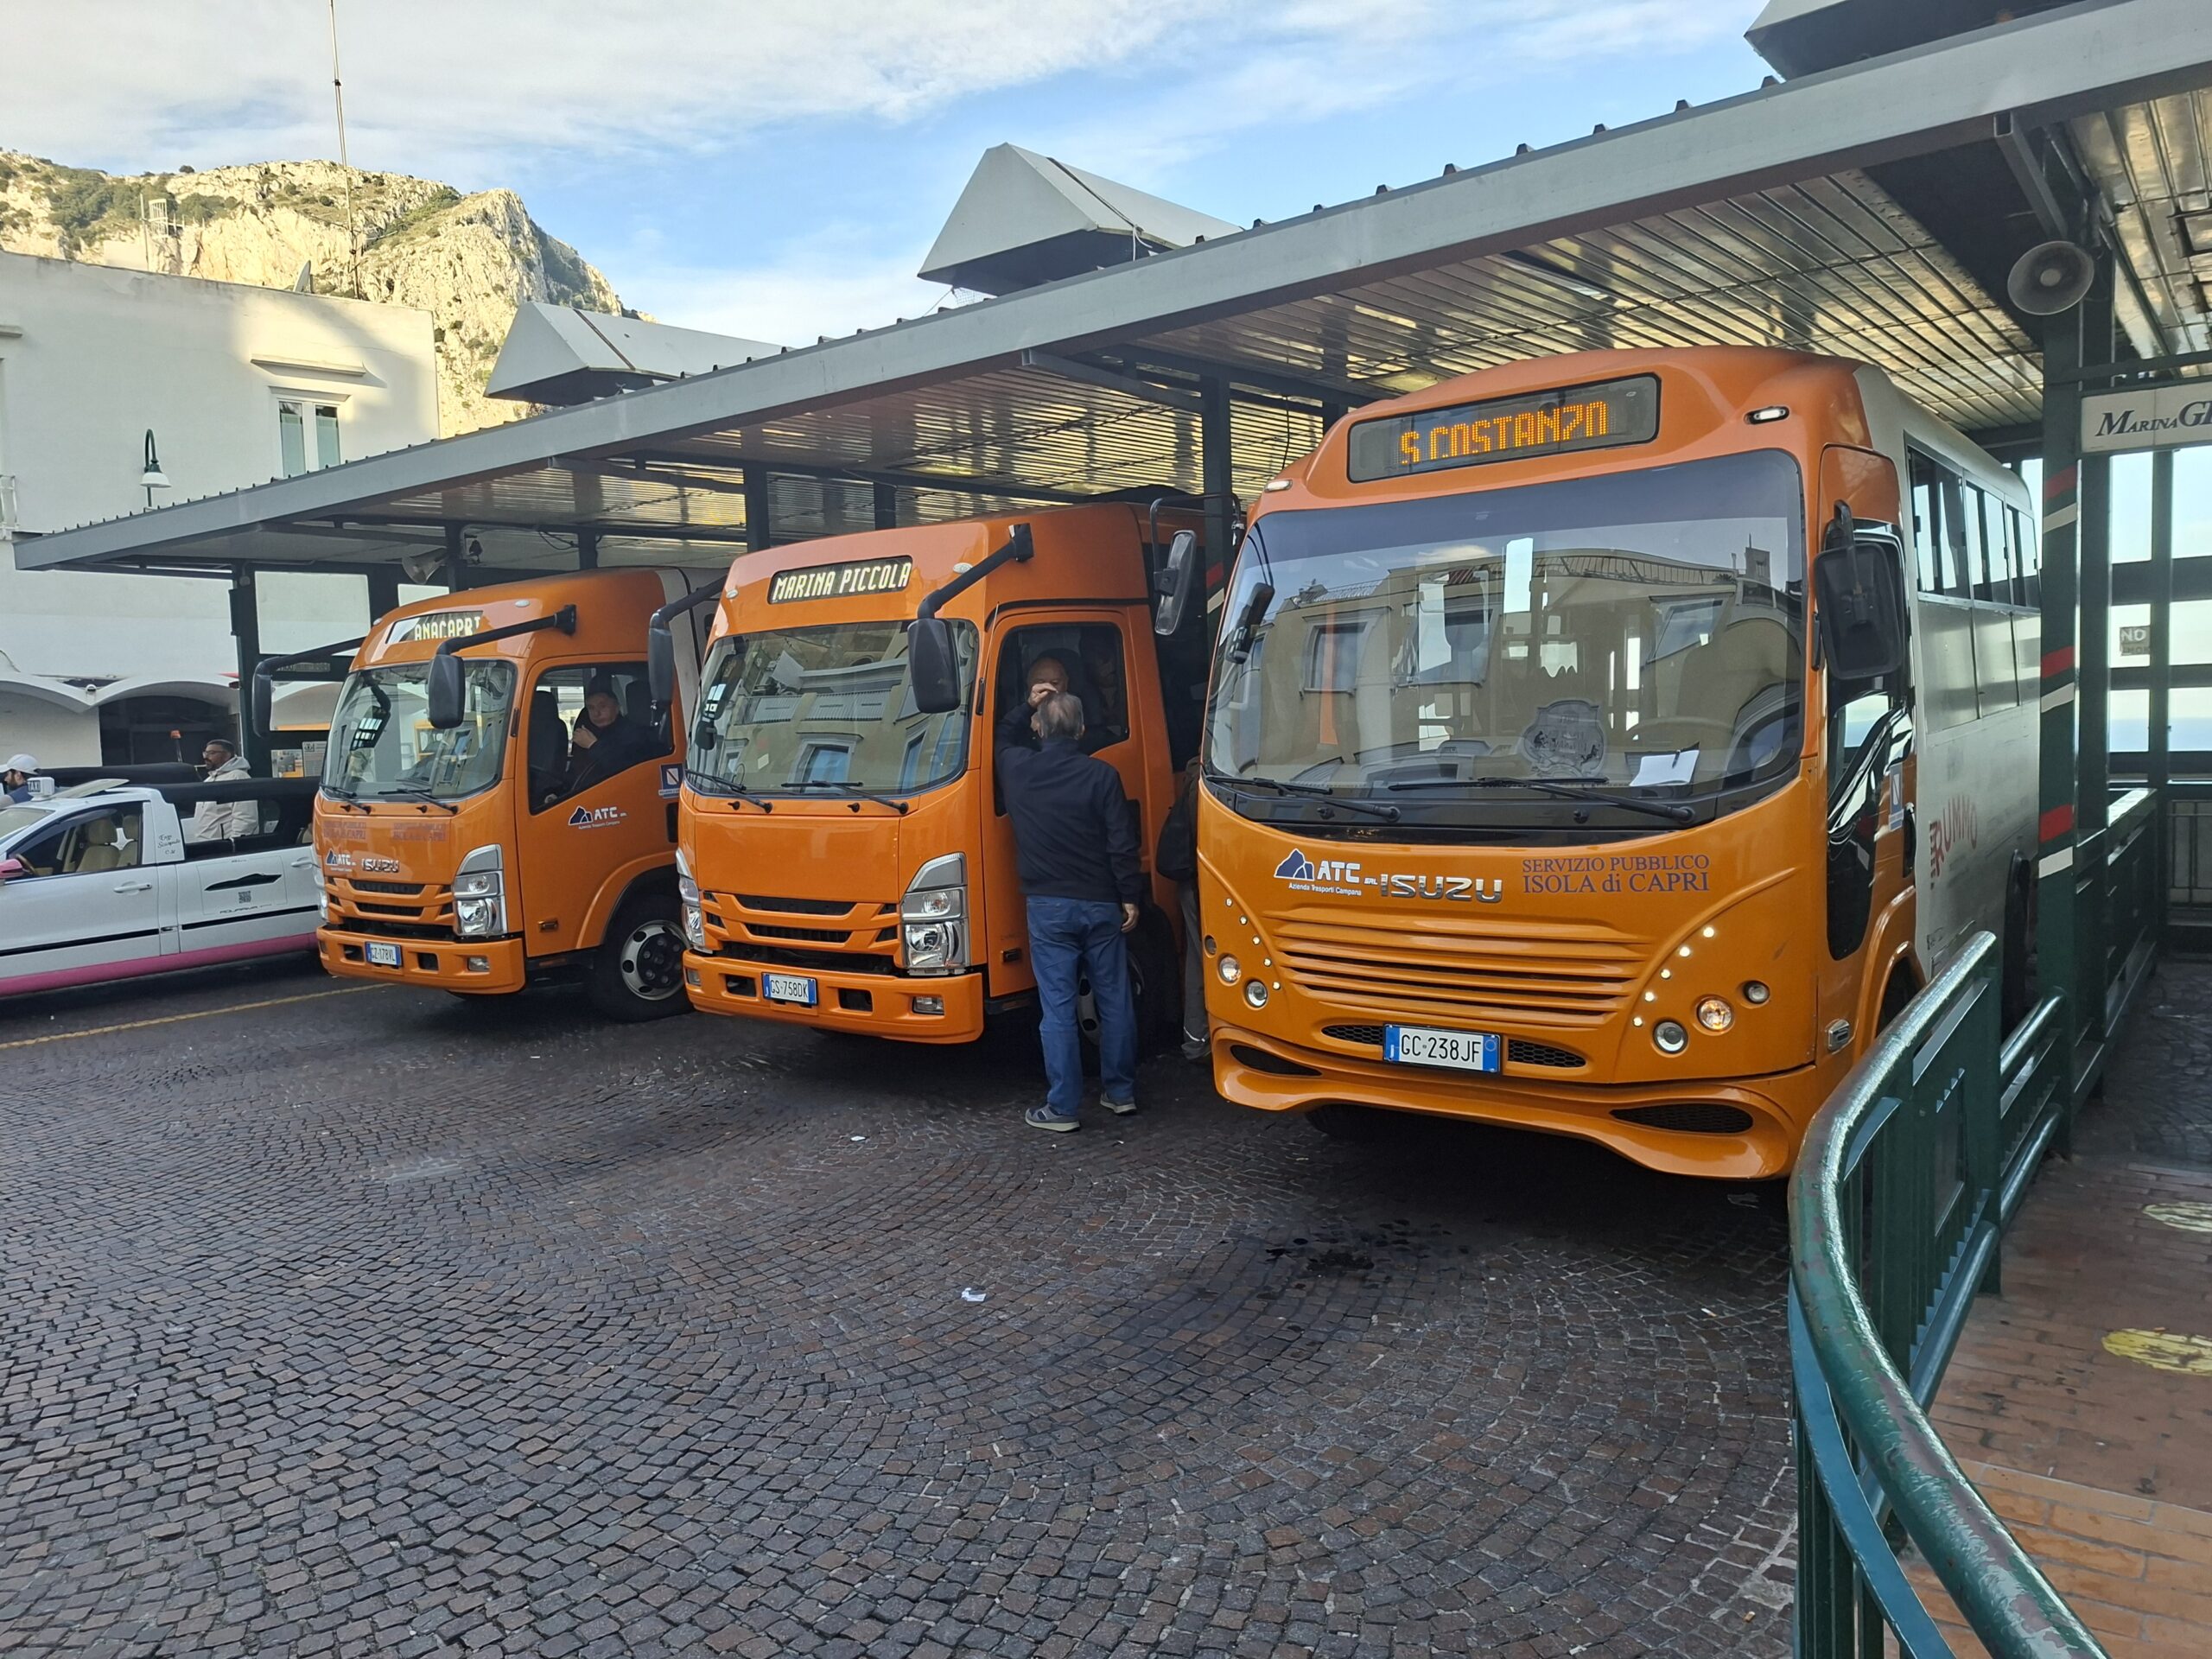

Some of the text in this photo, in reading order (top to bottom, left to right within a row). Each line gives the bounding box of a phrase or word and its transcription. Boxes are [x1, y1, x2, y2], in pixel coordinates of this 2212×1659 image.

[1402, 430, 1420, 464] S
[772, 563, 912, 601] MARINA PICCOLA
[2120, 627, 2146, 642] NO
[594, 806, 618, 821] ATC
[337, 854, 352, 866] ATC
[361, 858, 399, 874] ISUZU
[1522, 855, 1709, 873] SERVIZIO PUBBLICO
[1317, 860, 1360, 883] ATC
[1288, 882, 1362, 896] Azienda Trasporti Campana
[1381, 874, 1502, 903] ISUZU
[1523, 871, 1709, 893] ISOLA di CAPRI
